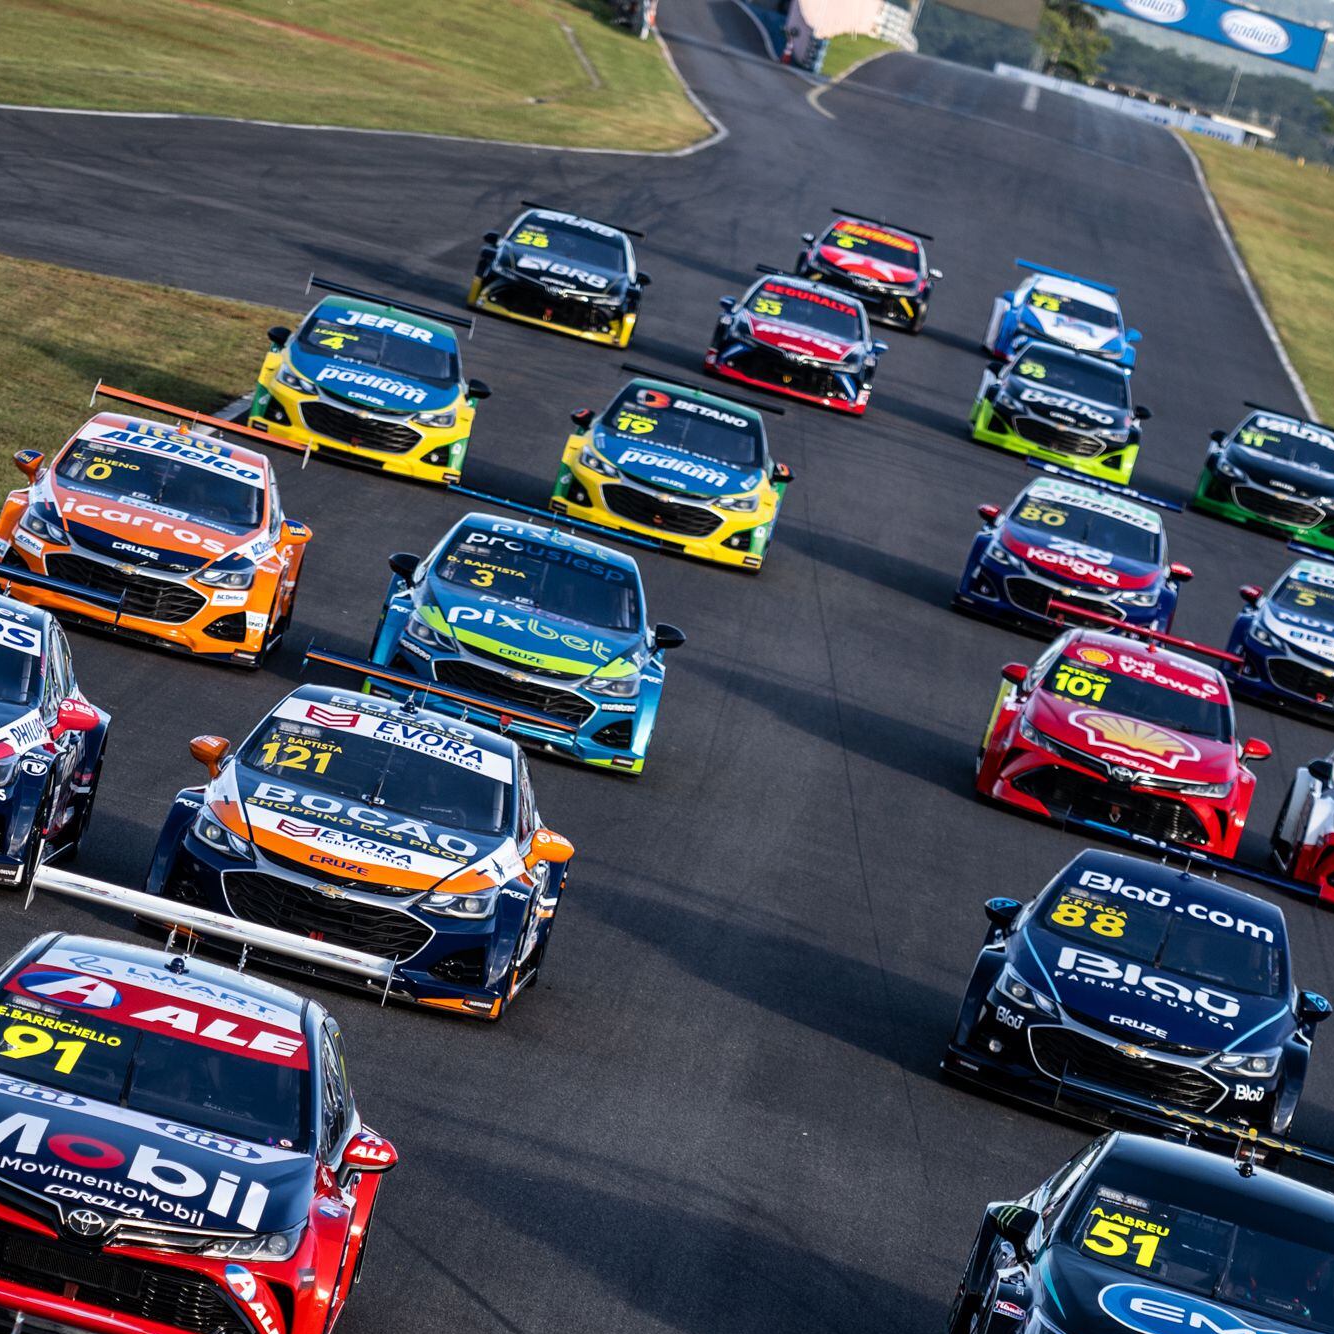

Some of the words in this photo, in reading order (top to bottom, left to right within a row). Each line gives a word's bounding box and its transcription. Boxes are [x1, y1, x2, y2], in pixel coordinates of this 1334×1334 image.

[337, 310, 433, 343] JEFER
[755, 323, 843, 354] MOTUL
[320, 336, 344, 350] 4
[316, 367, 428, 404] podium
[348, 391, 385, 406] CRUZE
[617, 418, 654, 434] 19
[673, 400, 748, 428] BETANO
[94, 456, 140, 471] BUENO
[101, 430, 261, 481] ACDelco
[616, 433, 688, 455] RICHARD
[691, 451, 741, 471] MILLE
[86, 464, 112, 481] 0
[618, 449, 729, 488] podium
[651, 475, 687, 490] CRUZE
[62, 498, 225, 554] icarros
[1020, 507, 1066, 526] 80
[112, 541, 159, 561] CRUZE
[492, 524, 608, 560] pixbet
[448, 555, 461, 564] D.
[464, 559, 526, 579] BAPTISTA
[470, 570, 495, 587] 3
[1295, 594, 1316, 607] 5
[447, 605, 612, 661] pixbet
[499, 647, 544, 665] CRUZE
[1119, 656, 1156, 672] Shell
[1056, 673, 1107, 702] 101
[1120, 664, 1211, 699] V-Power
[10, 717, 47, 747] PHILIPS
[329, 702, 396, 722] SHOPPING
[399, 718, 430, 732] DOS
[433, 727, 471, 745] PISOS
[262, 741, 333, 774] 121
[271, 734, 281, 743] F.
[287, 736, 343, 754] BAPTISTA
[373, 732, 481, 771] Lubrificantes
[376, 720, 482, 764] EVORA
[245, 797, 354, 826] SHOPPING
[359, 823, 404, 842] DOS
[409, 838, 468, 865] PISOS
[253, 782, 478, 857] BOCÃO
[317, 837, 410, 870] Lubrificantes
[319, 829, 412, 865] EVORA
[309, 854, 369, 877] CRUZE
[1051, 904, 1126, 938] 88
[1060, 895, 1128, 919] F.FRAGA
[128, 967, 278, 1016] LWART
[129, 1005, 304, 1057] ALE
[1109, 1014, 1168, 1039] CRUZE
[44, 1184, 145, 1219] COROLLA
[1091, 1207, 1170, 1237] A.ABREU
[1084, 1219, 1160, 1268] 51
